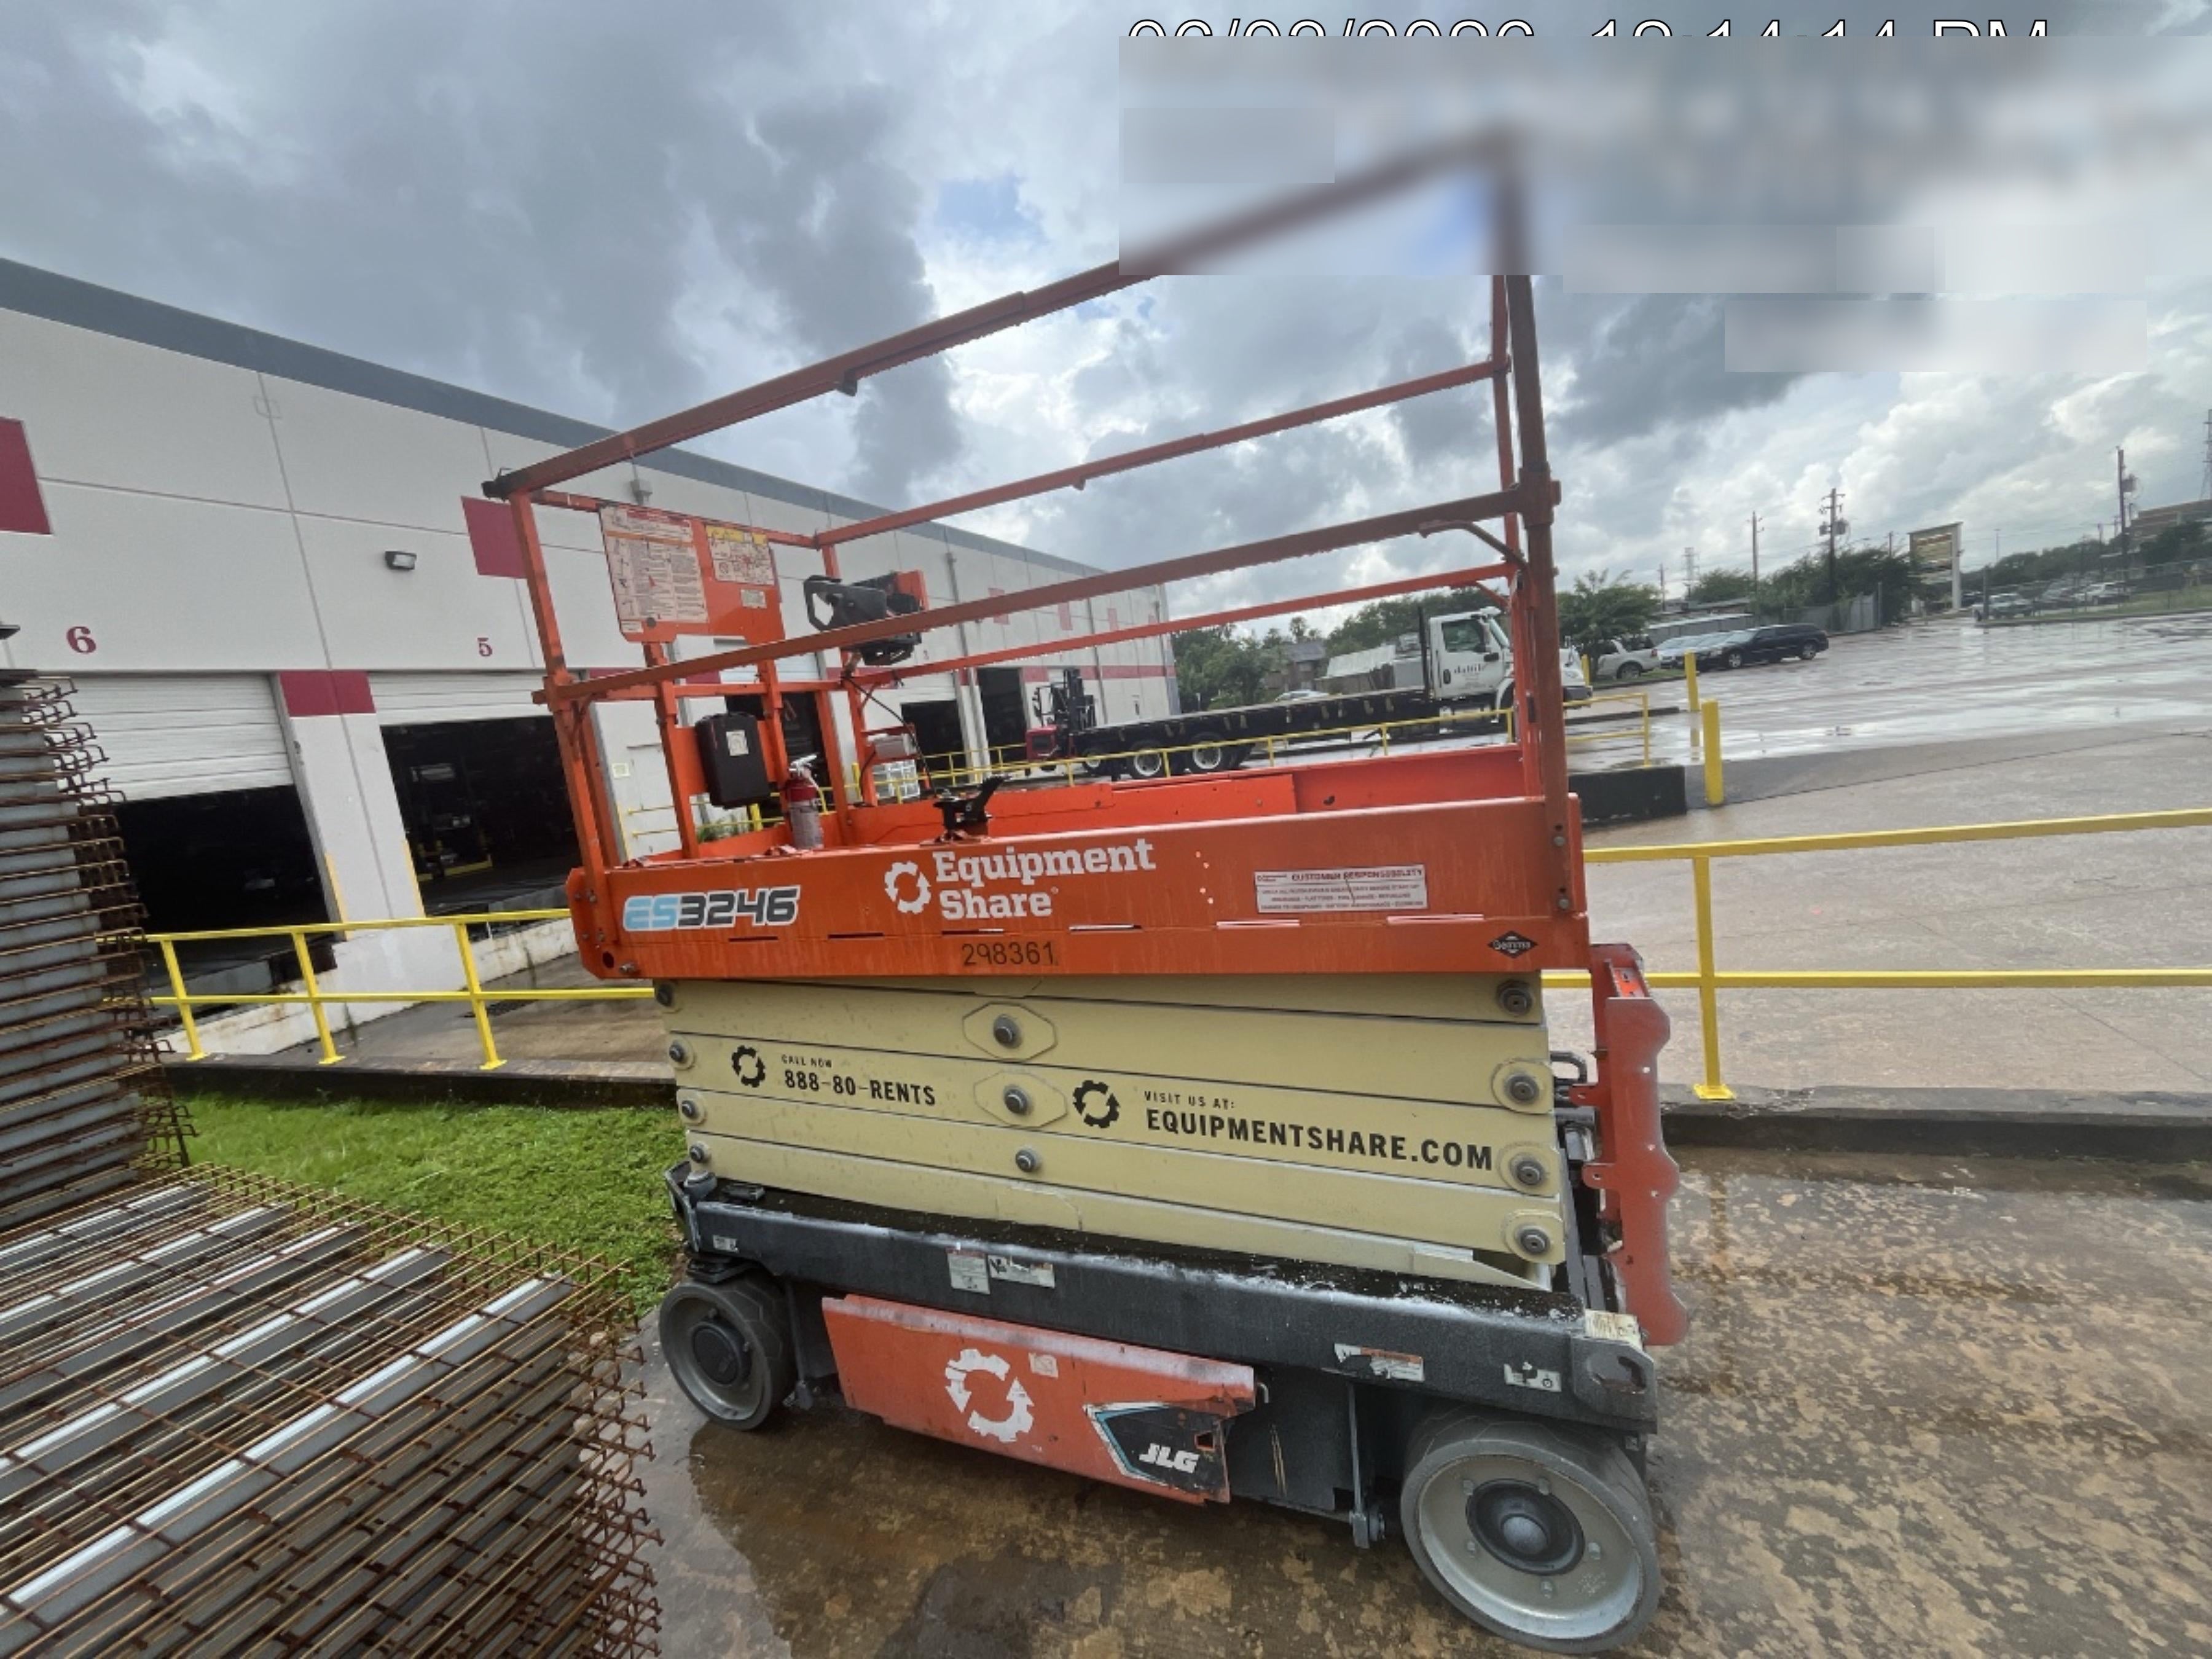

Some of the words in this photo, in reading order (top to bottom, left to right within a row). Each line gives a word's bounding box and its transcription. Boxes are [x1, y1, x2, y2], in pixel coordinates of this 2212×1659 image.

[66, 626, 96, 654] 6
[477, 637, 493, 657] 5
[931, 838, 1156, 888] Equipment
[623, 885, 801, 931] ES3246
[961, 941, 1056, 967] 298361
[781, 1054, 806, 1066] CALL
[810, 1056, 833, 1068] NOW
[784, 1069, 936, 1106] 888-80-RENTS
[1143, 1090, 1181, 1105] VISIT
[1188, 1095, 1206, 1107] US
[1212, 1097, 1235, 1110] AT:
[1146, 1108, 1492, 1171] EQUIPMENTSHARE.COM
[1139, 1442, 1200, 1474] JLG
